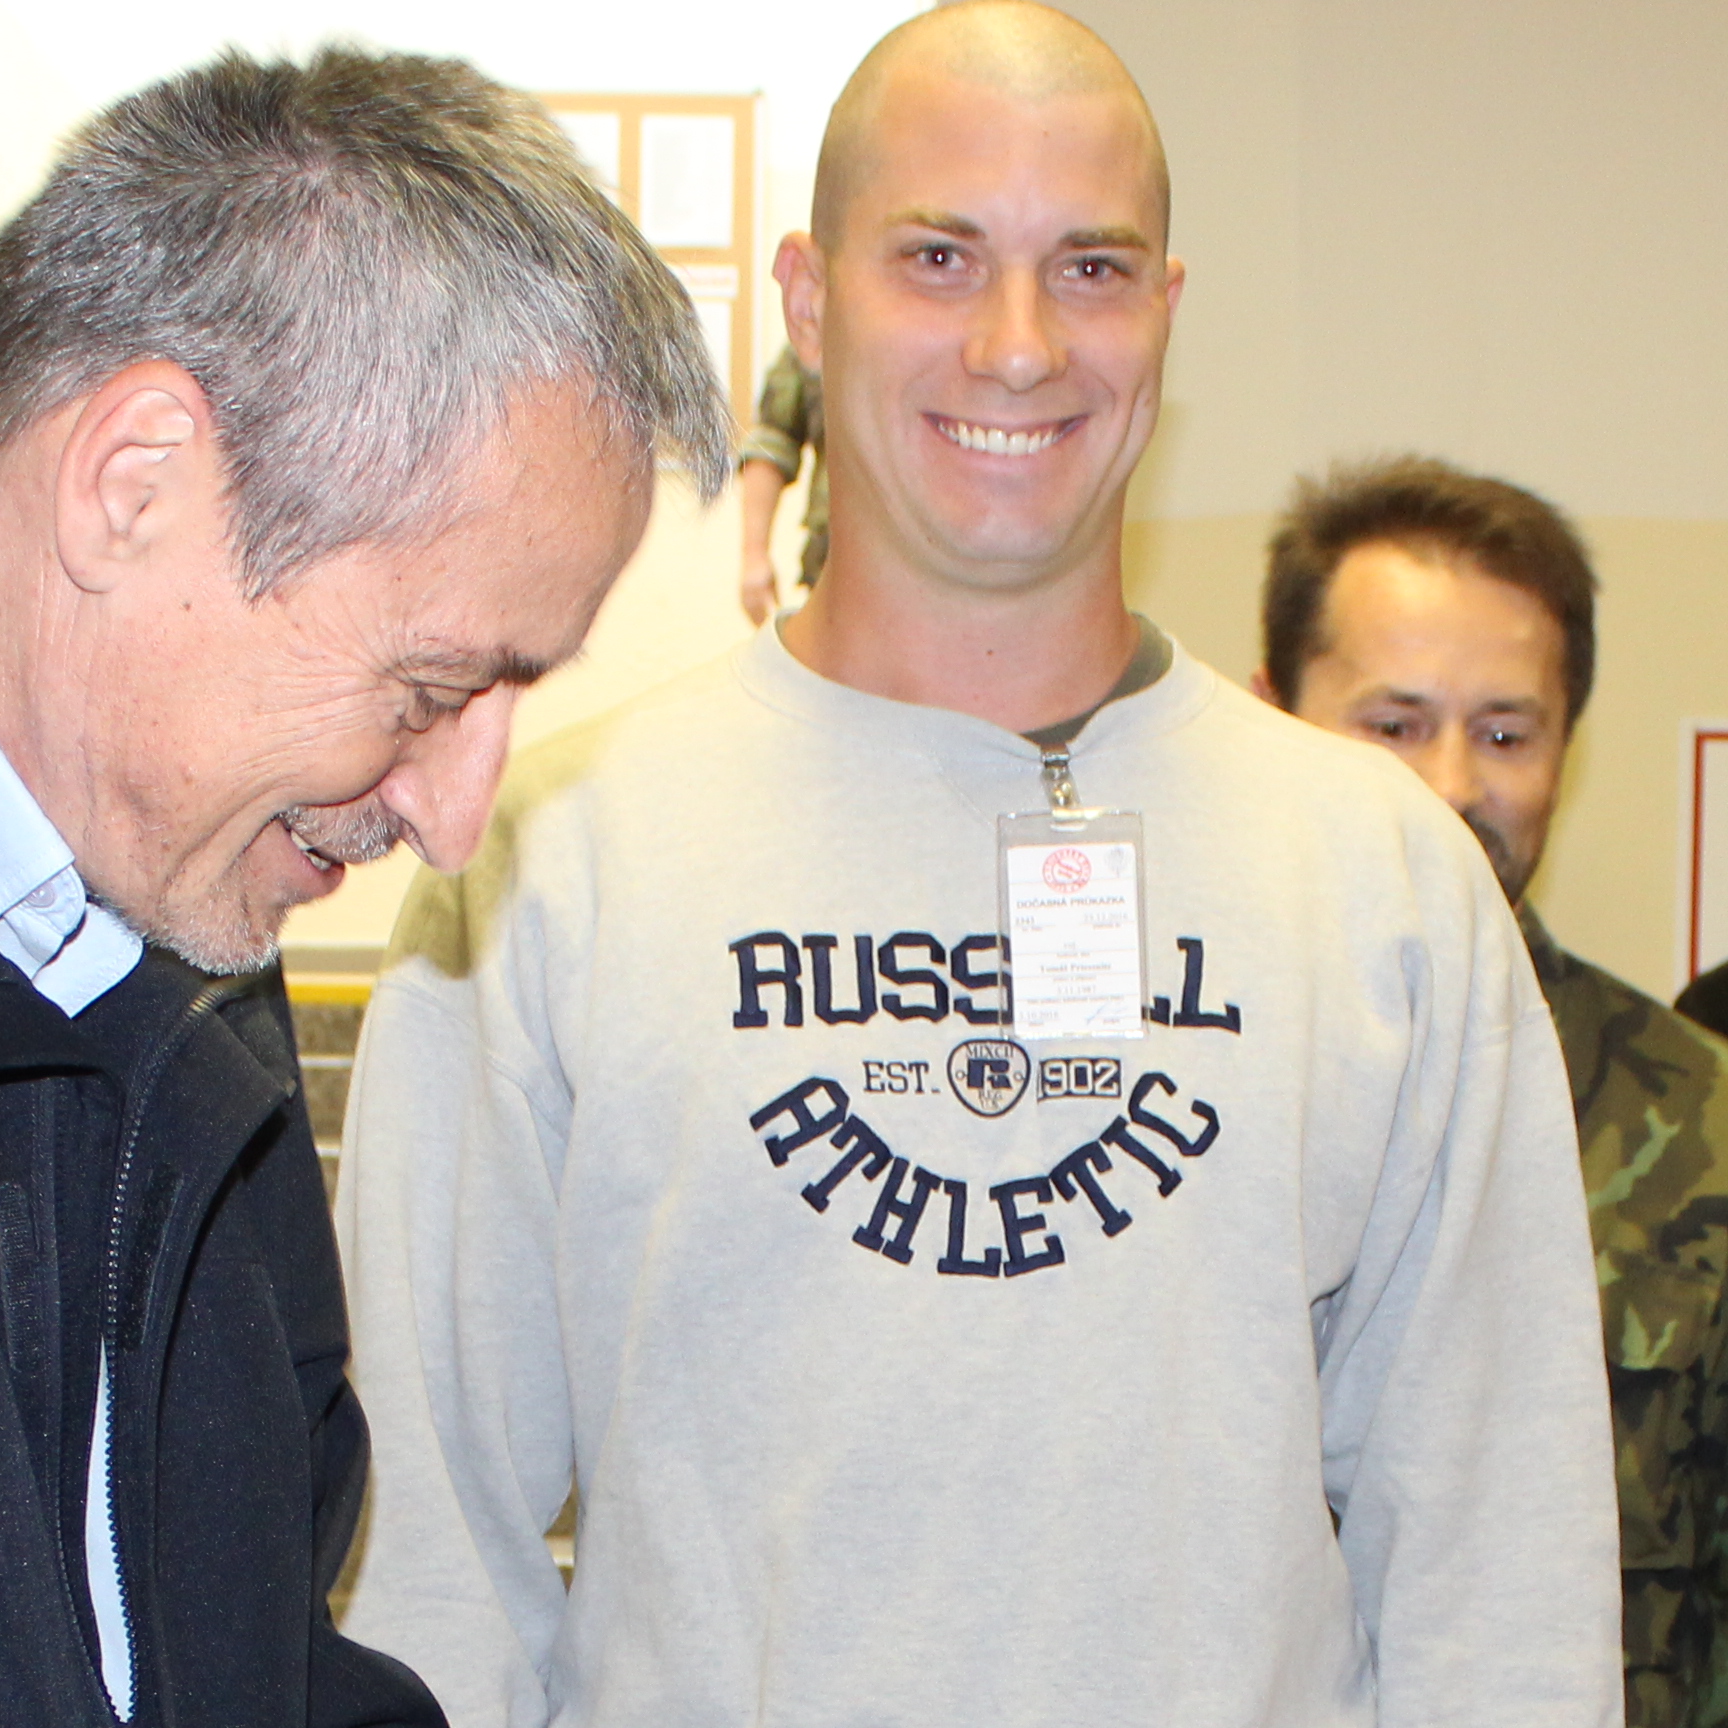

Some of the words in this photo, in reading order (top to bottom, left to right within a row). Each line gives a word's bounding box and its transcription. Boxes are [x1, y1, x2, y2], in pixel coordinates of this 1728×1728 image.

[729, 931, 1241, 1034] RUSSL
[862, 1059, 941, 1094] EST.
[749, 1074, 1220, 1278] ATHLETIC
